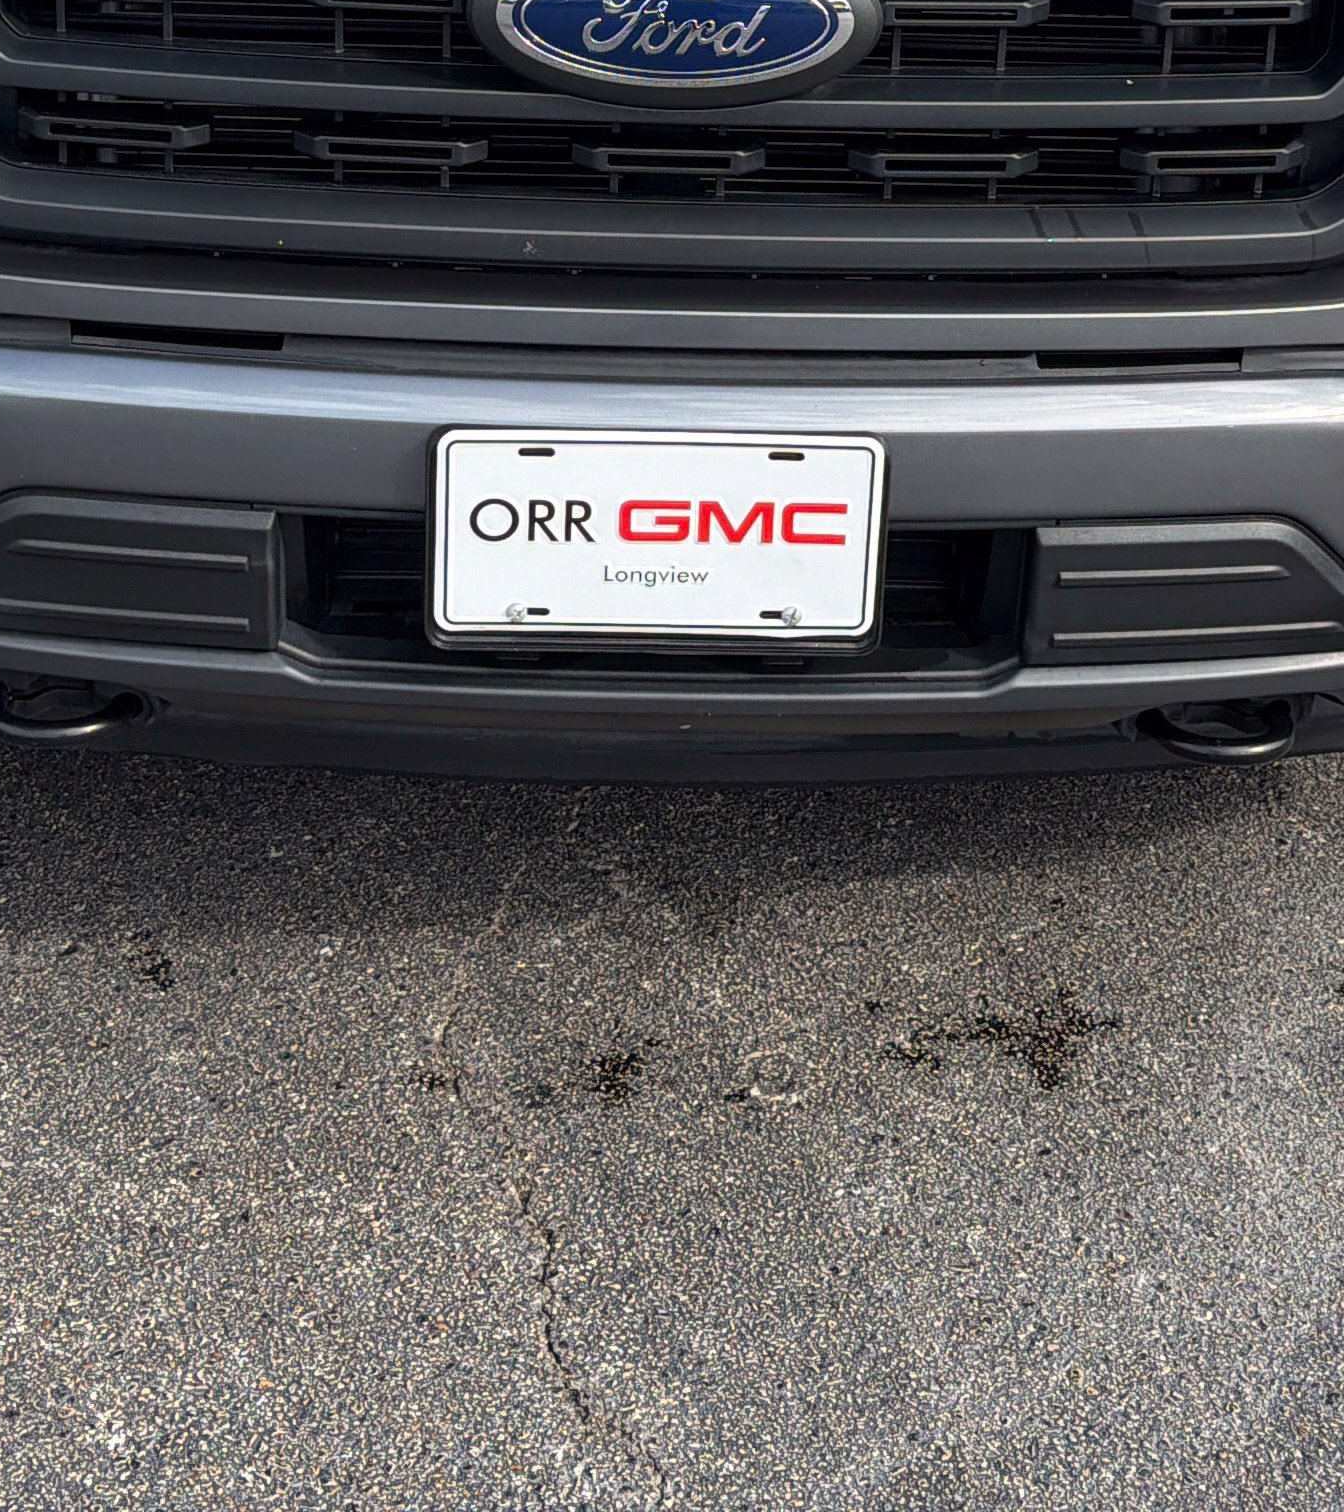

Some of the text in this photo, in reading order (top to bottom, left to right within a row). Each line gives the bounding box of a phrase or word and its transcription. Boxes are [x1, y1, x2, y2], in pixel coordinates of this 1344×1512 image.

[469, 497, 849, 546] ORR GMC
[603, 564, 710, 587] Longview
